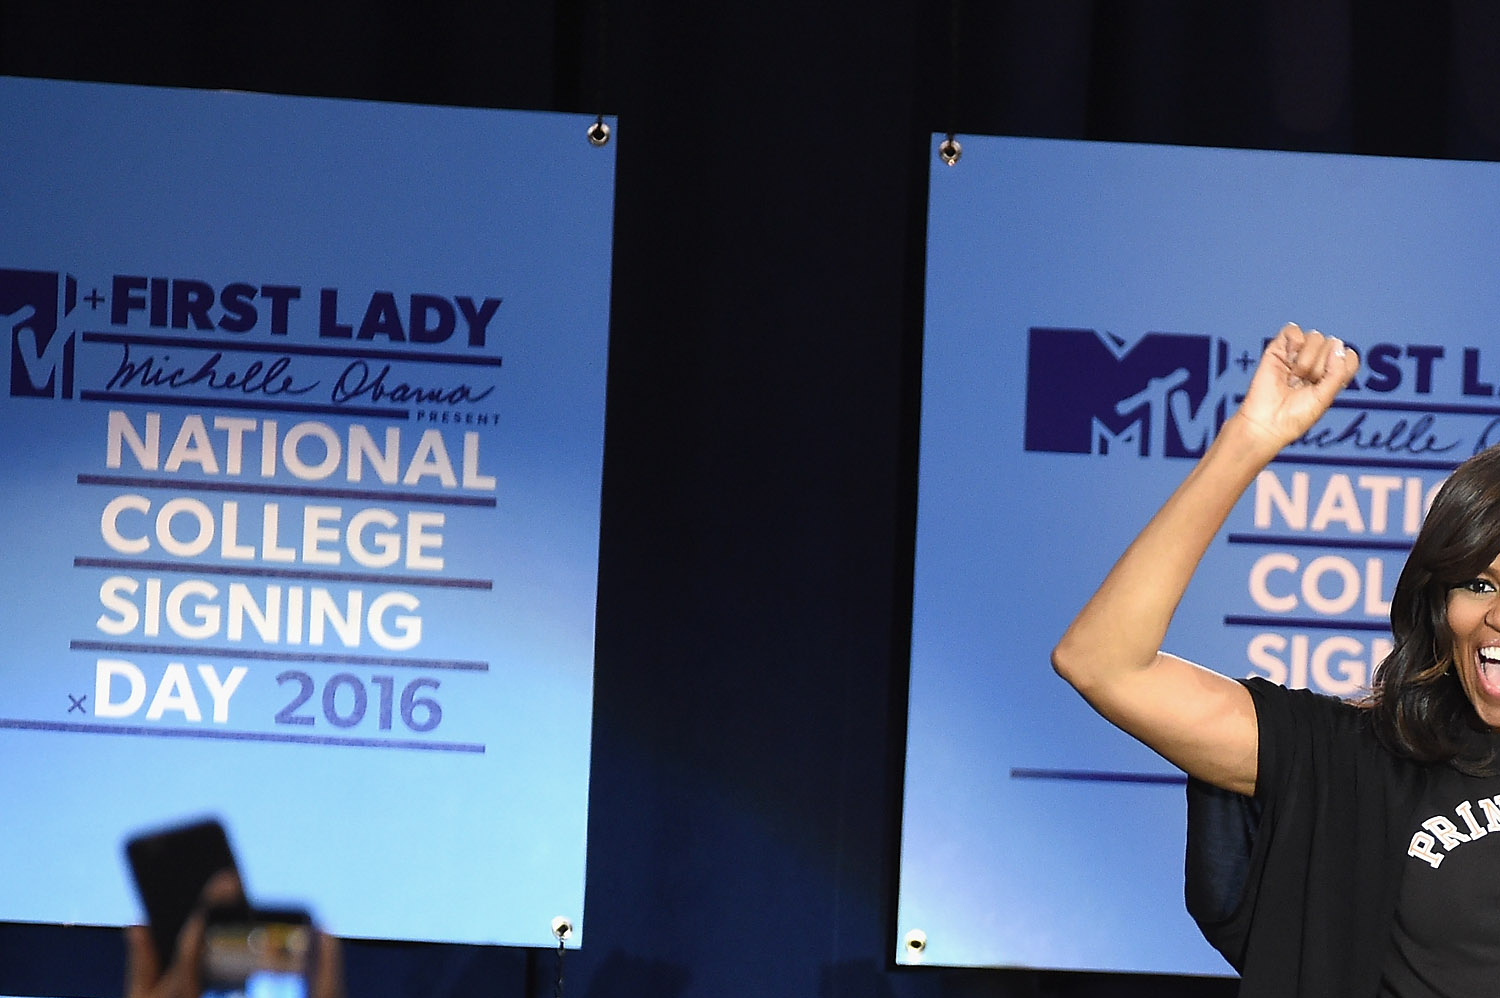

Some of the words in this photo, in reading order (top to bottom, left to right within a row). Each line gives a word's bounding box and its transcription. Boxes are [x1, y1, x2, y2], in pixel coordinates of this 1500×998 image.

[110, 274, 301, 336] FIRST
[318, 287, 502, 348] LADY
[106, 343, 320, 394] Michelle
[332, 359, 497, 404] Obama
[1024, 326, 1230, 459] MTV
[106, 410, 497, 491] NATIONAL
[100, 494, 446, 571] COLLEGE
[96, 576, 423, 651] SIGNING
[93, 658, 248, 724] DAY
[274, 668, 444, 733] 2016
